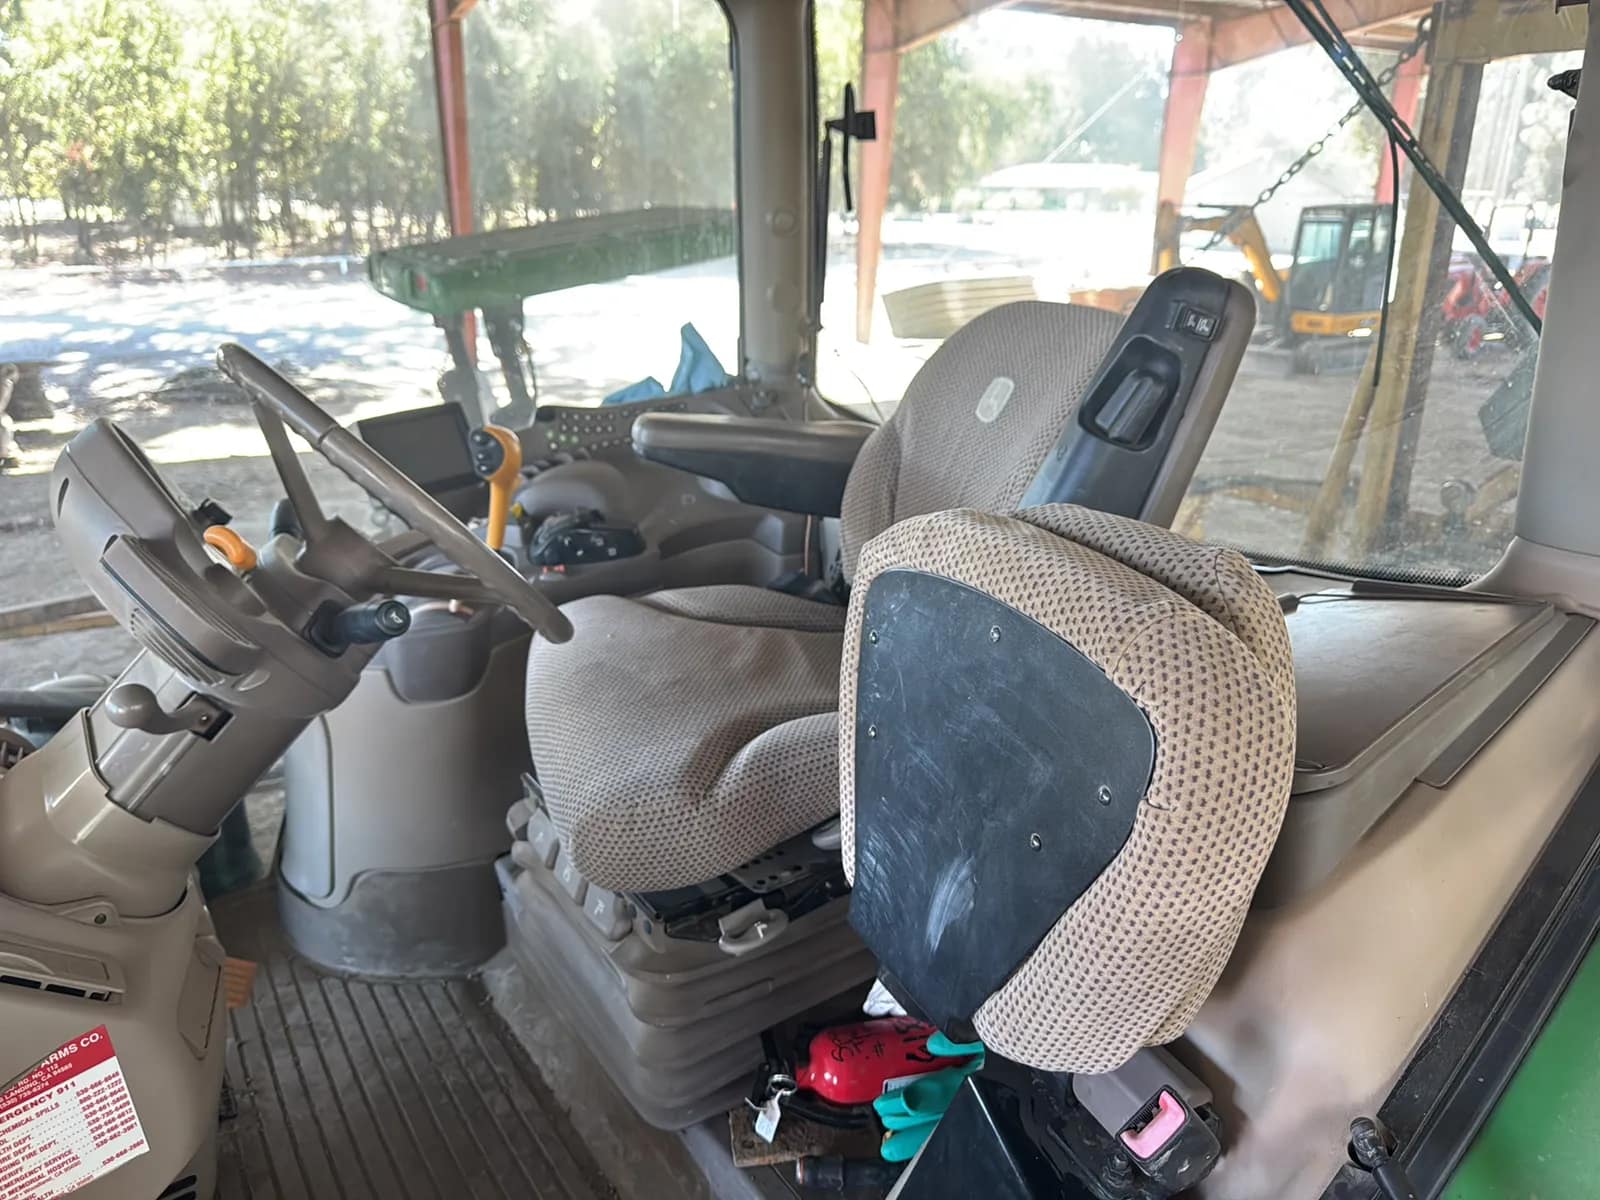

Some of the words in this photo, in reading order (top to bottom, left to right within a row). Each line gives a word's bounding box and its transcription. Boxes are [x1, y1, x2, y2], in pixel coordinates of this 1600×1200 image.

[35, 1043, 78, 1070] ARMS
[80, 1032, 104, 1048] CO.
[56, 1081, 76, 1094] 911
[34, 1102, 59, 1117] SPILLS
[21, 1150, 37, 1161] FIRE
[38, 1138, 59, 1152] DEPT.
[43, 1149, 73, 1167] SERVICE
[7, 1173, 45, 1195] MEMORIAL
[46, 1154, 80, 1174] HOSPITAL
